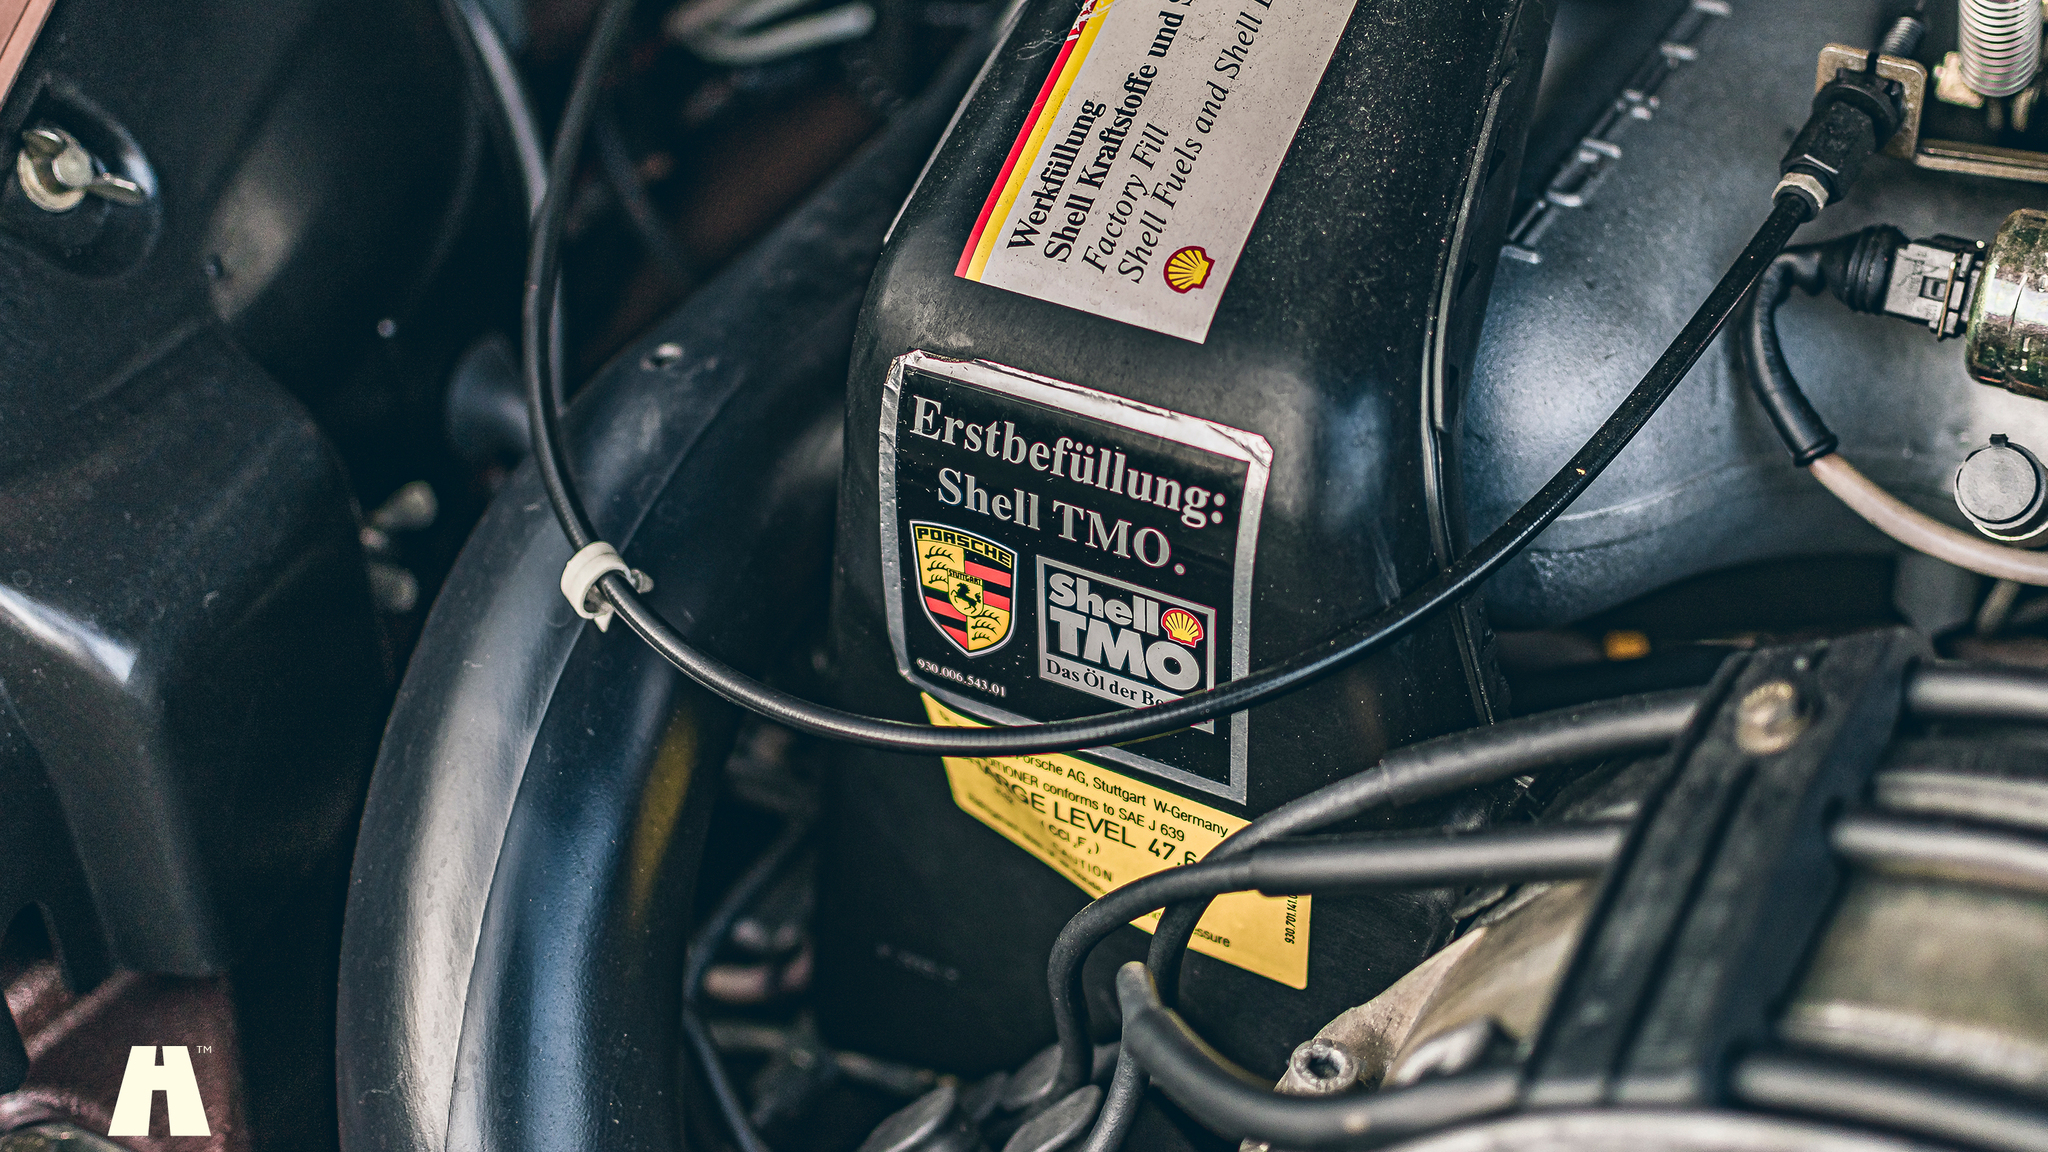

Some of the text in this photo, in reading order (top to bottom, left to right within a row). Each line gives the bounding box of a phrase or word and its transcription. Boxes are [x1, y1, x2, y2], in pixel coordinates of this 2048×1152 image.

[1007, 98, 1107, 250] Werkfüllung
[1044, 193, 1095, 263] Shell
[1077, 65, 1158, 191] Kraftstoffe
[1148, 10, 1185, 58] und
[1117, 11, 1263, 284] Shell Fuels and Shell
[1081, 120, 1170, 275] Factory Fill
[909, 395, 1226, 529] Erstbefüllung:
[917, 528, 1011, 568] PORSCHE
[937, 467, 1186, 576] Shell TMO.
[1049, 573, 1160, 636] Shell
[917, 658, 1006, 698] 930.006.543.01
[1047, 659, 1080, 682] Das
[1083, 668, 1105, 691] Öl
[1109, 680, 1138, 701] der
[1050, 606, 1200, 691] TMO
[1016, 755, 1229, 837] orsche AG, Stuttgart W-Germany
[1043, 782, 1099, 810] conforms
[1103, 803, 1115, 815] to
[1119, 808, 1145, 827] SAE
[1149, 820, 1156, 831] J
[1160, 823, 1185, 842] 639
[1054, 801, 1137, 848] LEVEL
